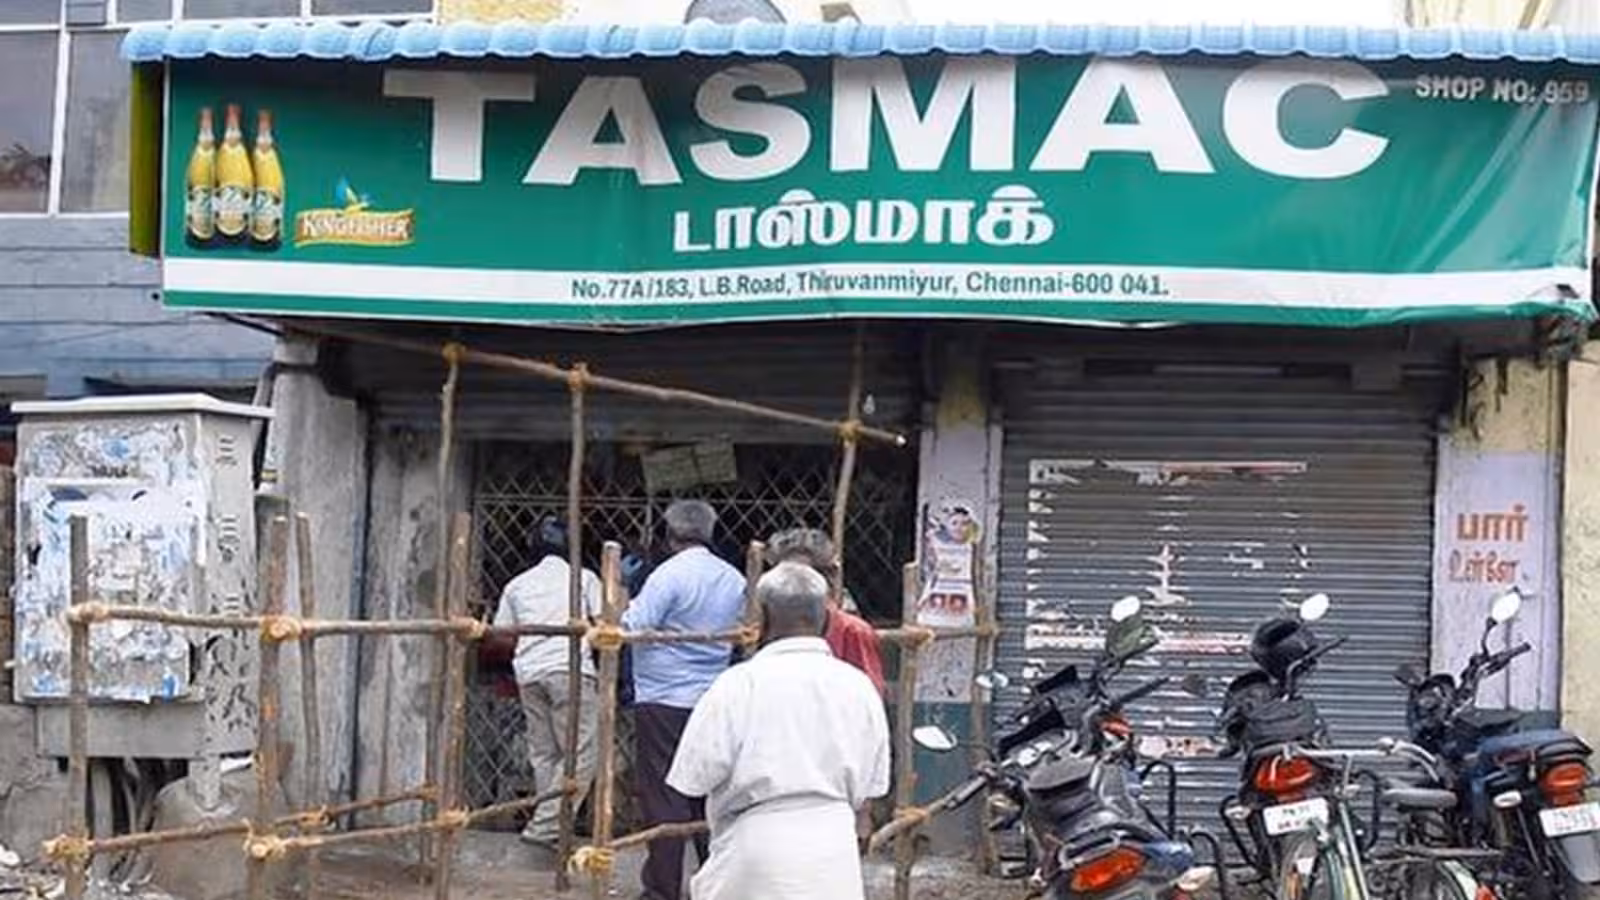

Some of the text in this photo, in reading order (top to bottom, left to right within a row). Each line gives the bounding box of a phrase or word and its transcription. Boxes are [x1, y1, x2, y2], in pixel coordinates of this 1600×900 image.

[1415, 74, 1486, 100] SHOP
[1493, 79, 1536, 102] NO:
[383, 57, 1388, 186] TASMAC
[673, 185, 1055, 252] டாஸ்மாக்
[796, 268, 958, 295] Thiruvanmiyur,
[965, 271, 1113, 293] Chennai-600
[1120, 274, 1169, 296] 041.
[1457, 505, 1529, 542] பார்
